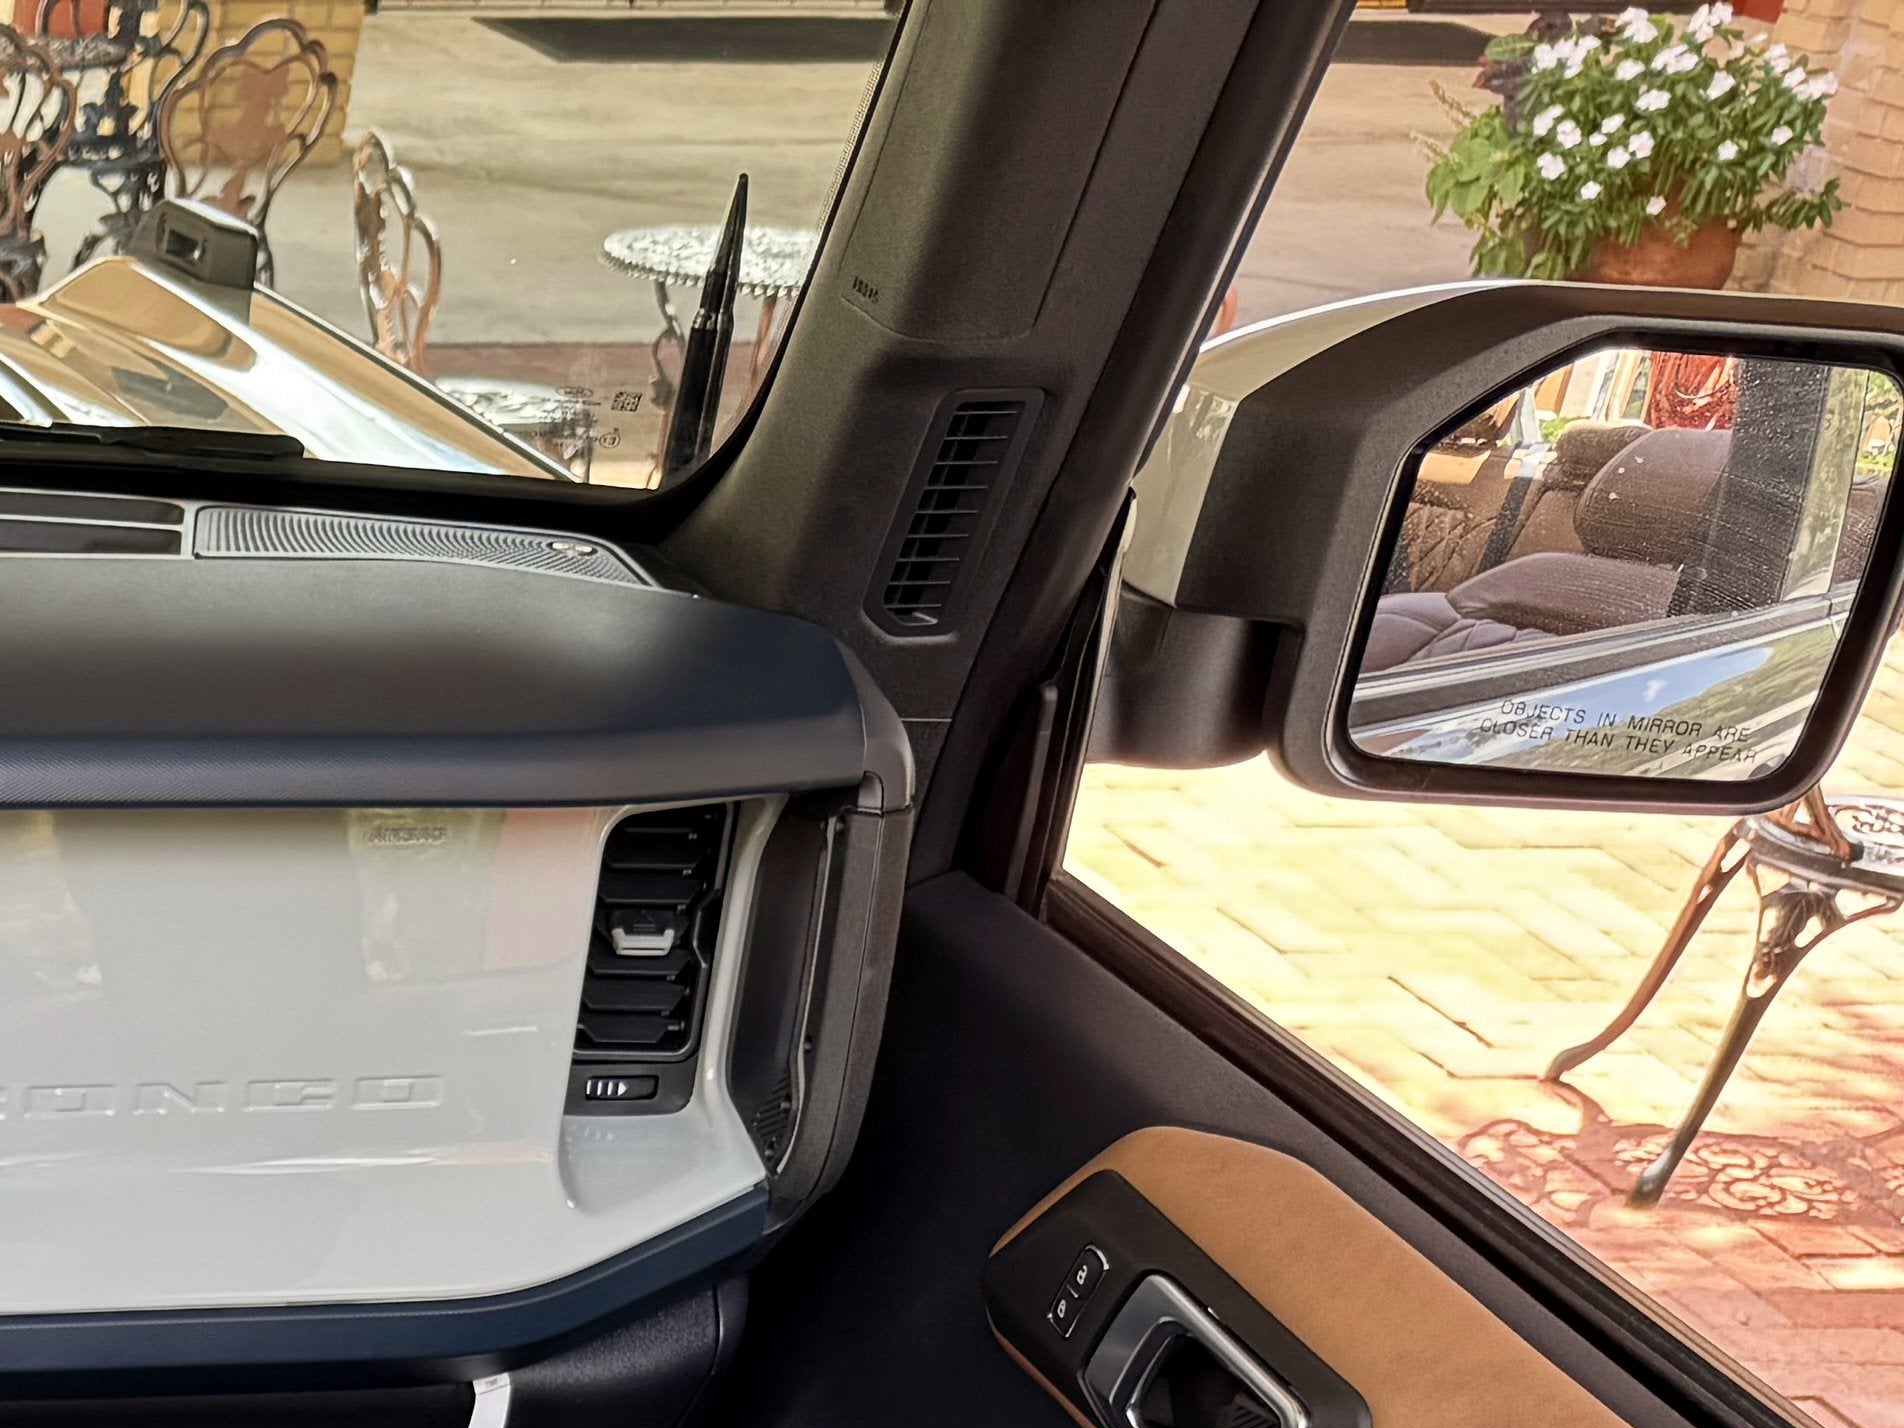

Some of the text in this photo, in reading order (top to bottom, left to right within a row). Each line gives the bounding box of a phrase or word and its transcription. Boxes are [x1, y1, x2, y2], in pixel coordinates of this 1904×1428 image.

[1480, 718, 1759, 763] CLOSER THAN THEY APPEAR
[1501, 700, 1752, 743] OBJECTS IN MIRROR ARE
